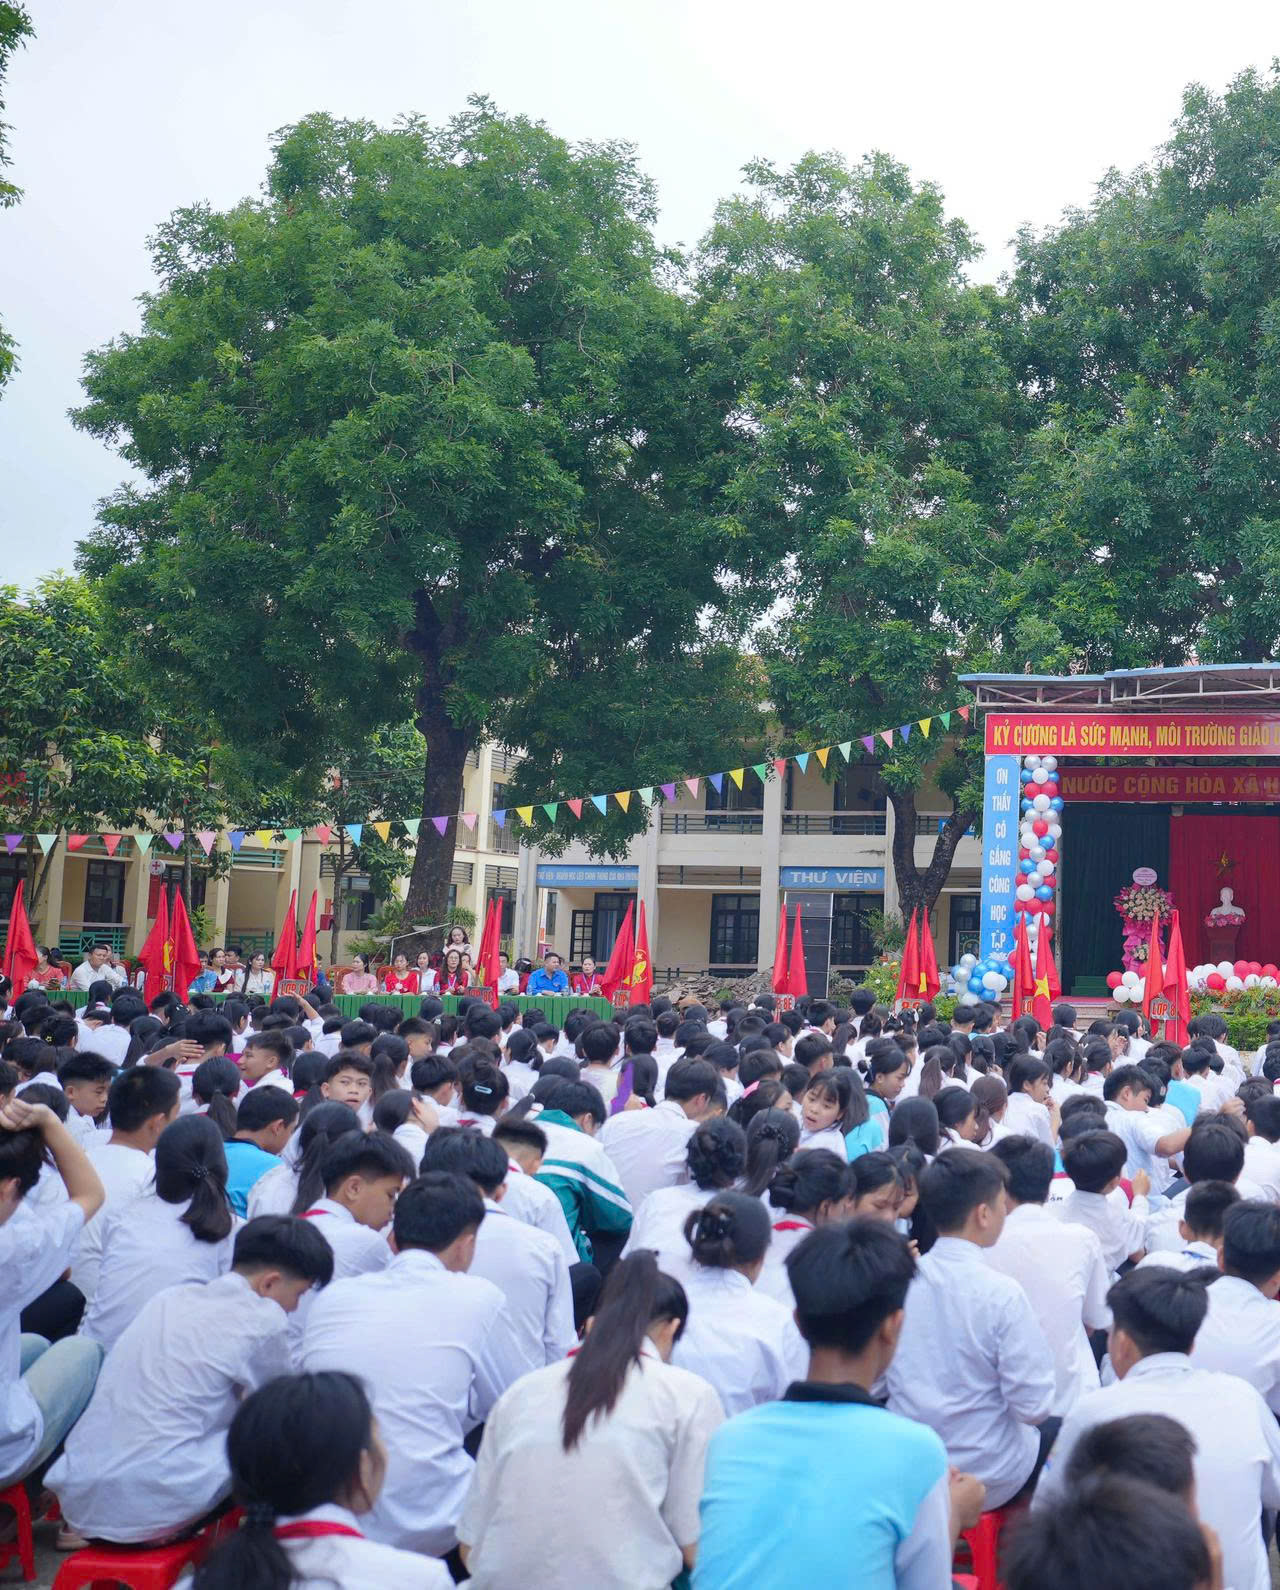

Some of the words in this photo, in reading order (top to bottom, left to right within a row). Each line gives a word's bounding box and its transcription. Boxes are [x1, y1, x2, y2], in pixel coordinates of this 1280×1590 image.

[993, 719, 1010, 746] KỶ
[1013, 725, 1057, 746] CƯƠNG
[1061, 722, 1077, 746] LÀ
[1080, 721, 1106, 746] SỨC
[1110, 726, 1152, 751] MẠNH,
[1156, 722, 1181, 746] MÔI
[1184, 721, 1236, 746] TRƯỜNG
[1239, 722, 1270, 746] GIÁO
[996, 768, 1008, 784] ƠN
[1062, 774, 1116, 794] NƯỚC
[1124, 774, 1180, 798] CỘNG
[1185, 774, 1225, 794] HÒA
[1232, 774, 1260, 794] XÃ
[790, 871, 828, 883] THƯ
[836, 869, 877, 887] VIỆN
[990, 904, 1007, 922] HỌC
